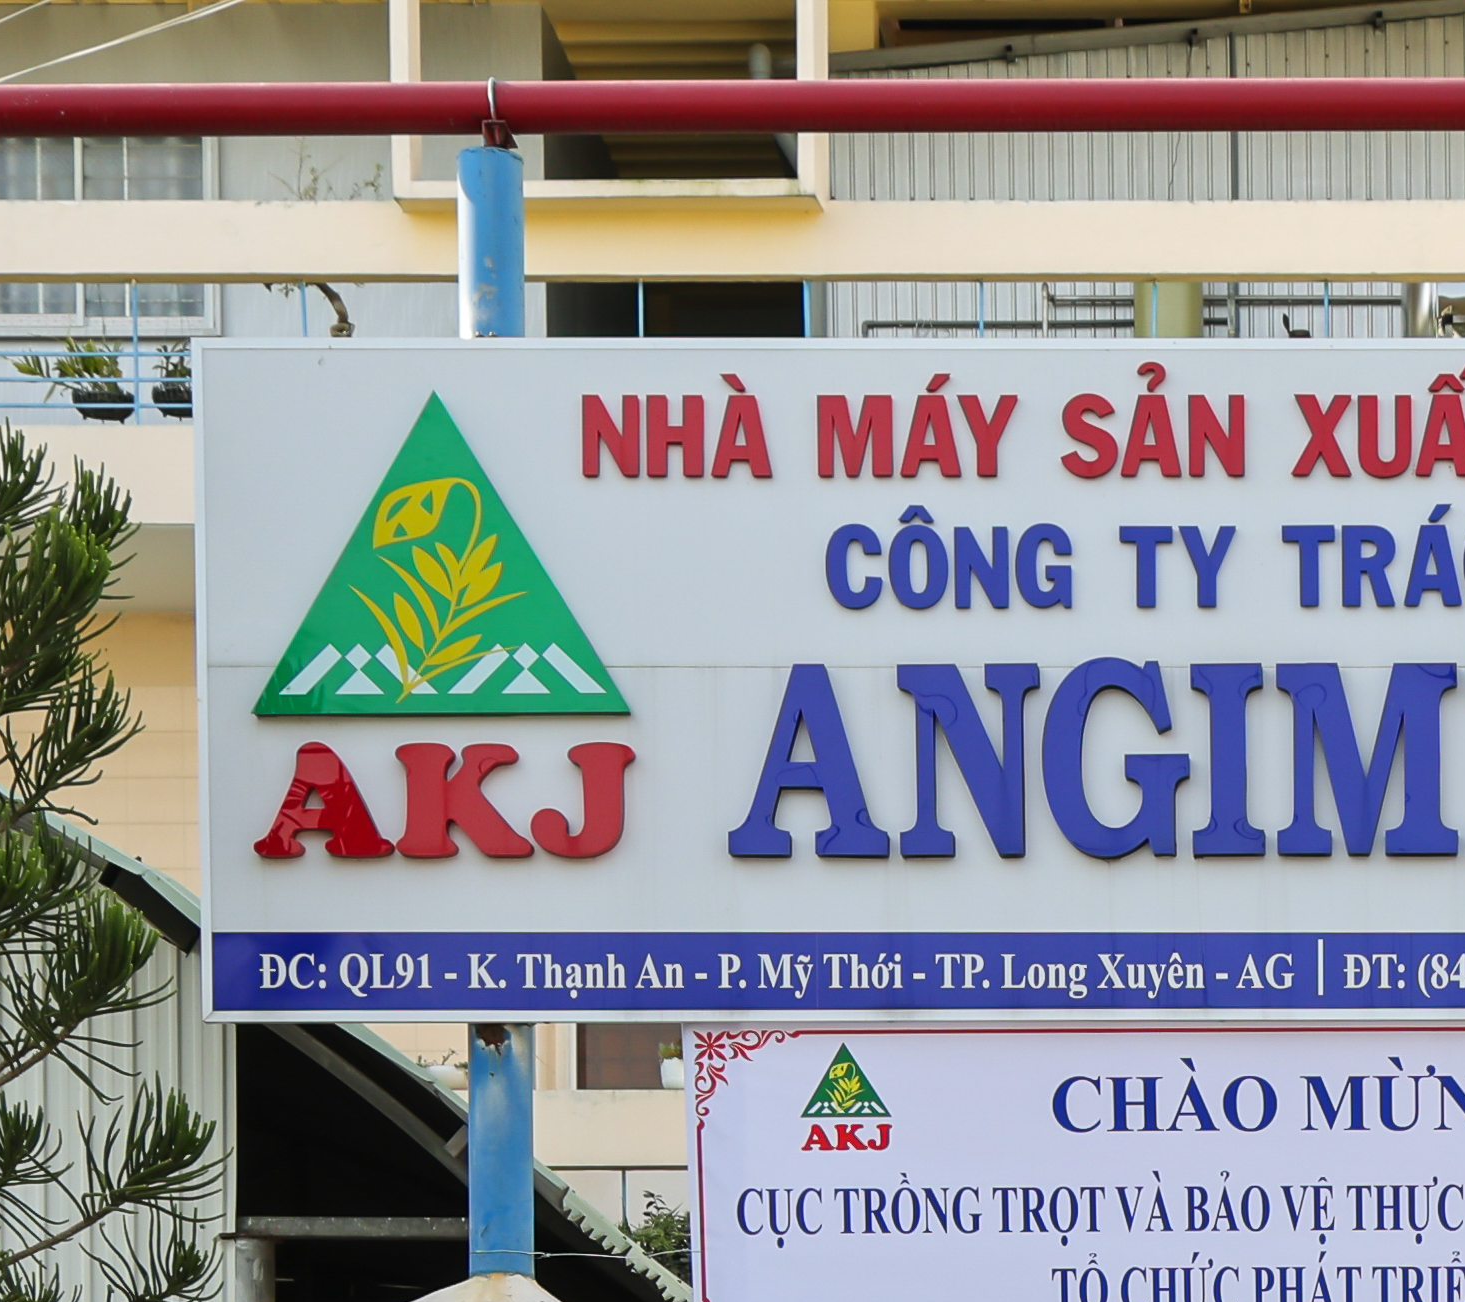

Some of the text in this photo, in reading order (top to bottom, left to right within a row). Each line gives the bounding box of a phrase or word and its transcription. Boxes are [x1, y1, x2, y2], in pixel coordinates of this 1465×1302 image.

[581, 373, 772, 478] NHÀ
[817, 373, 1017, 478] MÁY
[1061, 361, 1246, 480] SẢN
[825, 504, 1075, 610] CÔNG
[1118, 524, 1237, 609] TY
[253, 741, 636, 860] AKJ
[259, 953, 327, 991] ĐC:
[339, 952, 433, 999] QL91
[467, 953, 507, 990] K.
[516, 953, 627, 1000] Thạnh
[634, 953, 685, 990] An
[717, 953, 747, 990] P.
[757, 953, 814, 1000] Mỹ
[823, 952, 904, 990] Thới
[934, 953, 990, 990] TP.
[1000, 953, 1088, 1000] Long
[1096, 952, 1206, 1000] Xuyên
[1235, 953, 1295, 991] AG
[1342, 953, 1406, 991] ĐT:
[1053, 1058, 1279, 1135] CHÀO
[802, 1123, 892, 1152] AKJ
[737, 1187, 823, 1250] CỤC
[833, 1172, 983, 1236] TRỒNG
[993, 1185, 1109, 1248] TRỌT
[1118, 1170, 1174, 1233] VÀ
[1187, 1169, 1273, 1233] BẢO
[1282, 1176, 1335, 1245] VỆ
[1347, 1177, 1464, 1246] THỰC
